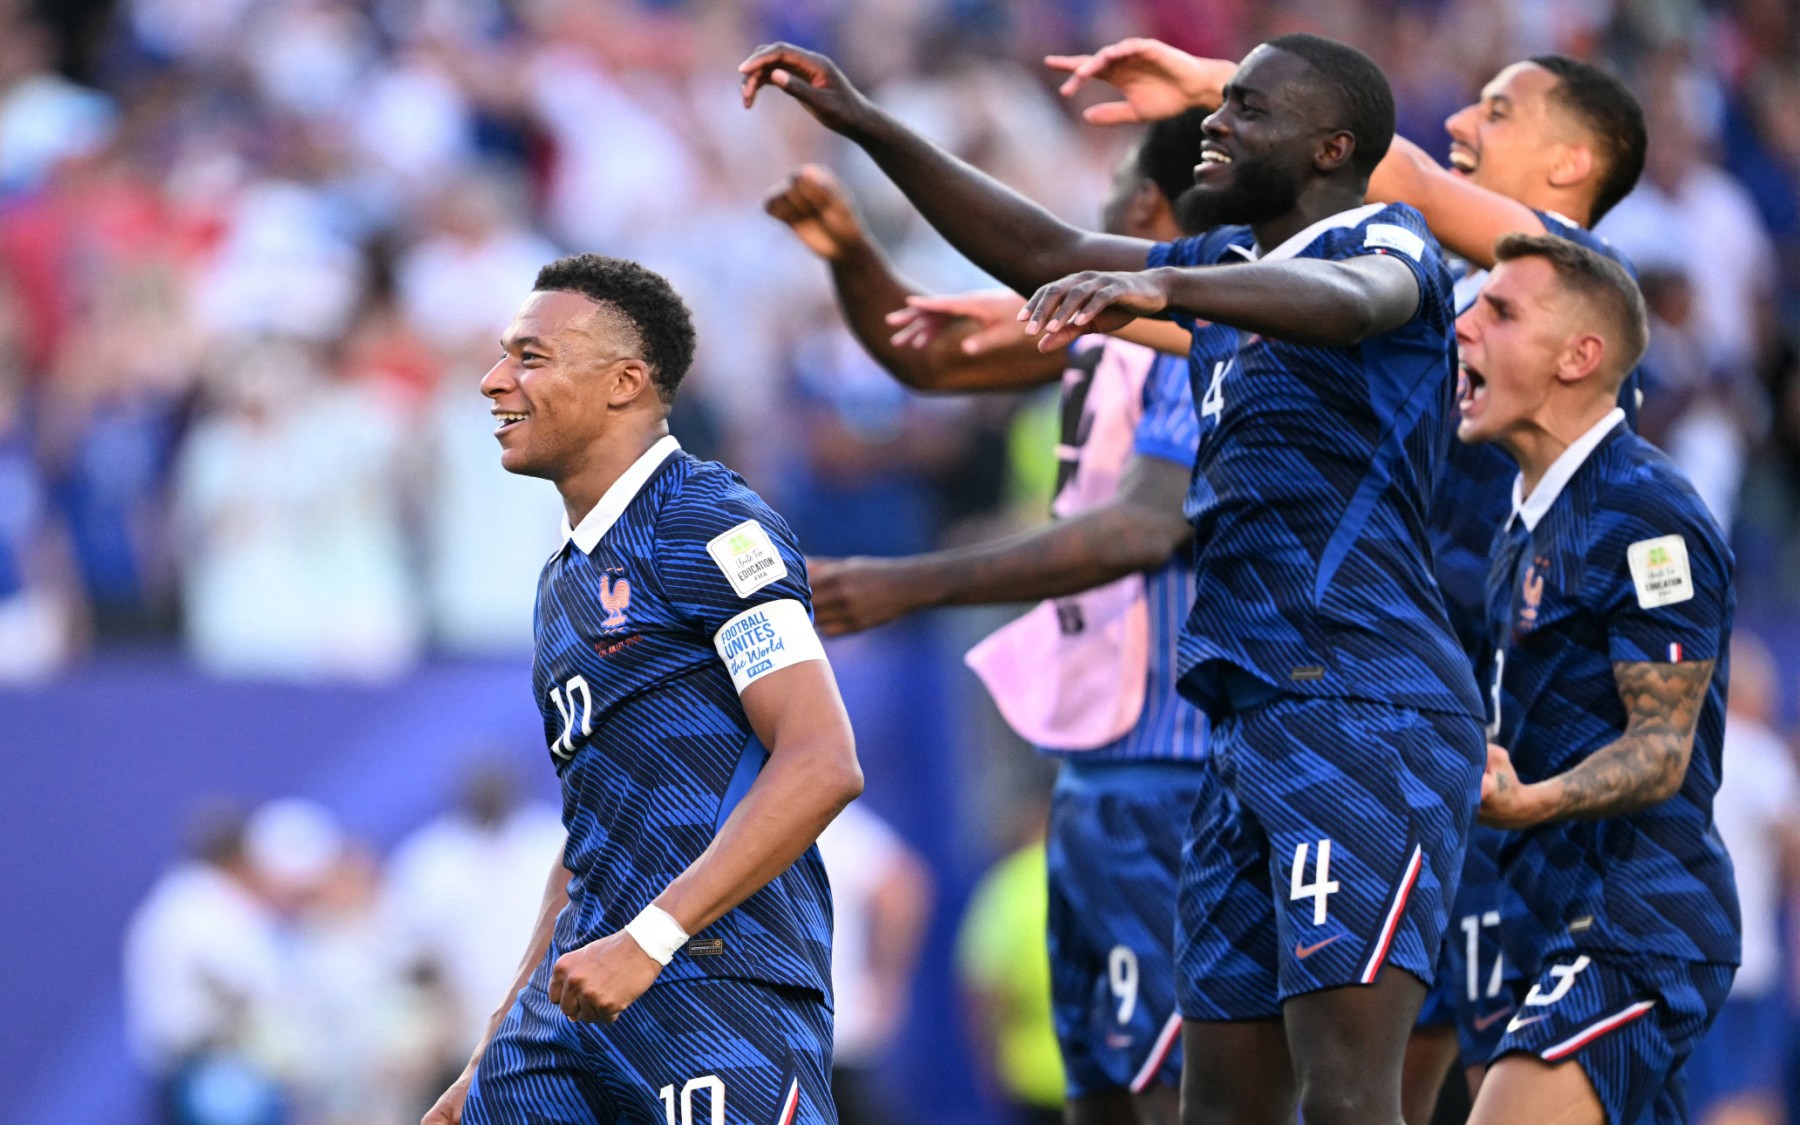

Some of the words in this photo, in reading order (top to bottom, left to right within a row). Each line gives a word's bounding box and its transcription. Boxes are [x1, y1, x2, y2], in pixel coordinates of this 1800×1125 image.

[1201, 358, 1234, 427] 4
[737, 556, 775, 581] EDUCATION
[754, 571, 768, 581] FIFA
[721, 611, 769, 644] FOOTBALL
[724, 622, 775, 659] UNITES
[731, 659, 747, 676] the
[746, 636, 785, 663] World
[747, 660, 773, 677] FIFA
[550, 674, 594, 761] 10
[1290, 838, 1340, 926] 4
[1461, 910, 1504, 1002] 17
[1525, 954, 1591, 1006] 3
[1108, 944, 1139, 1025] 9
[659, 1074, 725, 1125] 10
